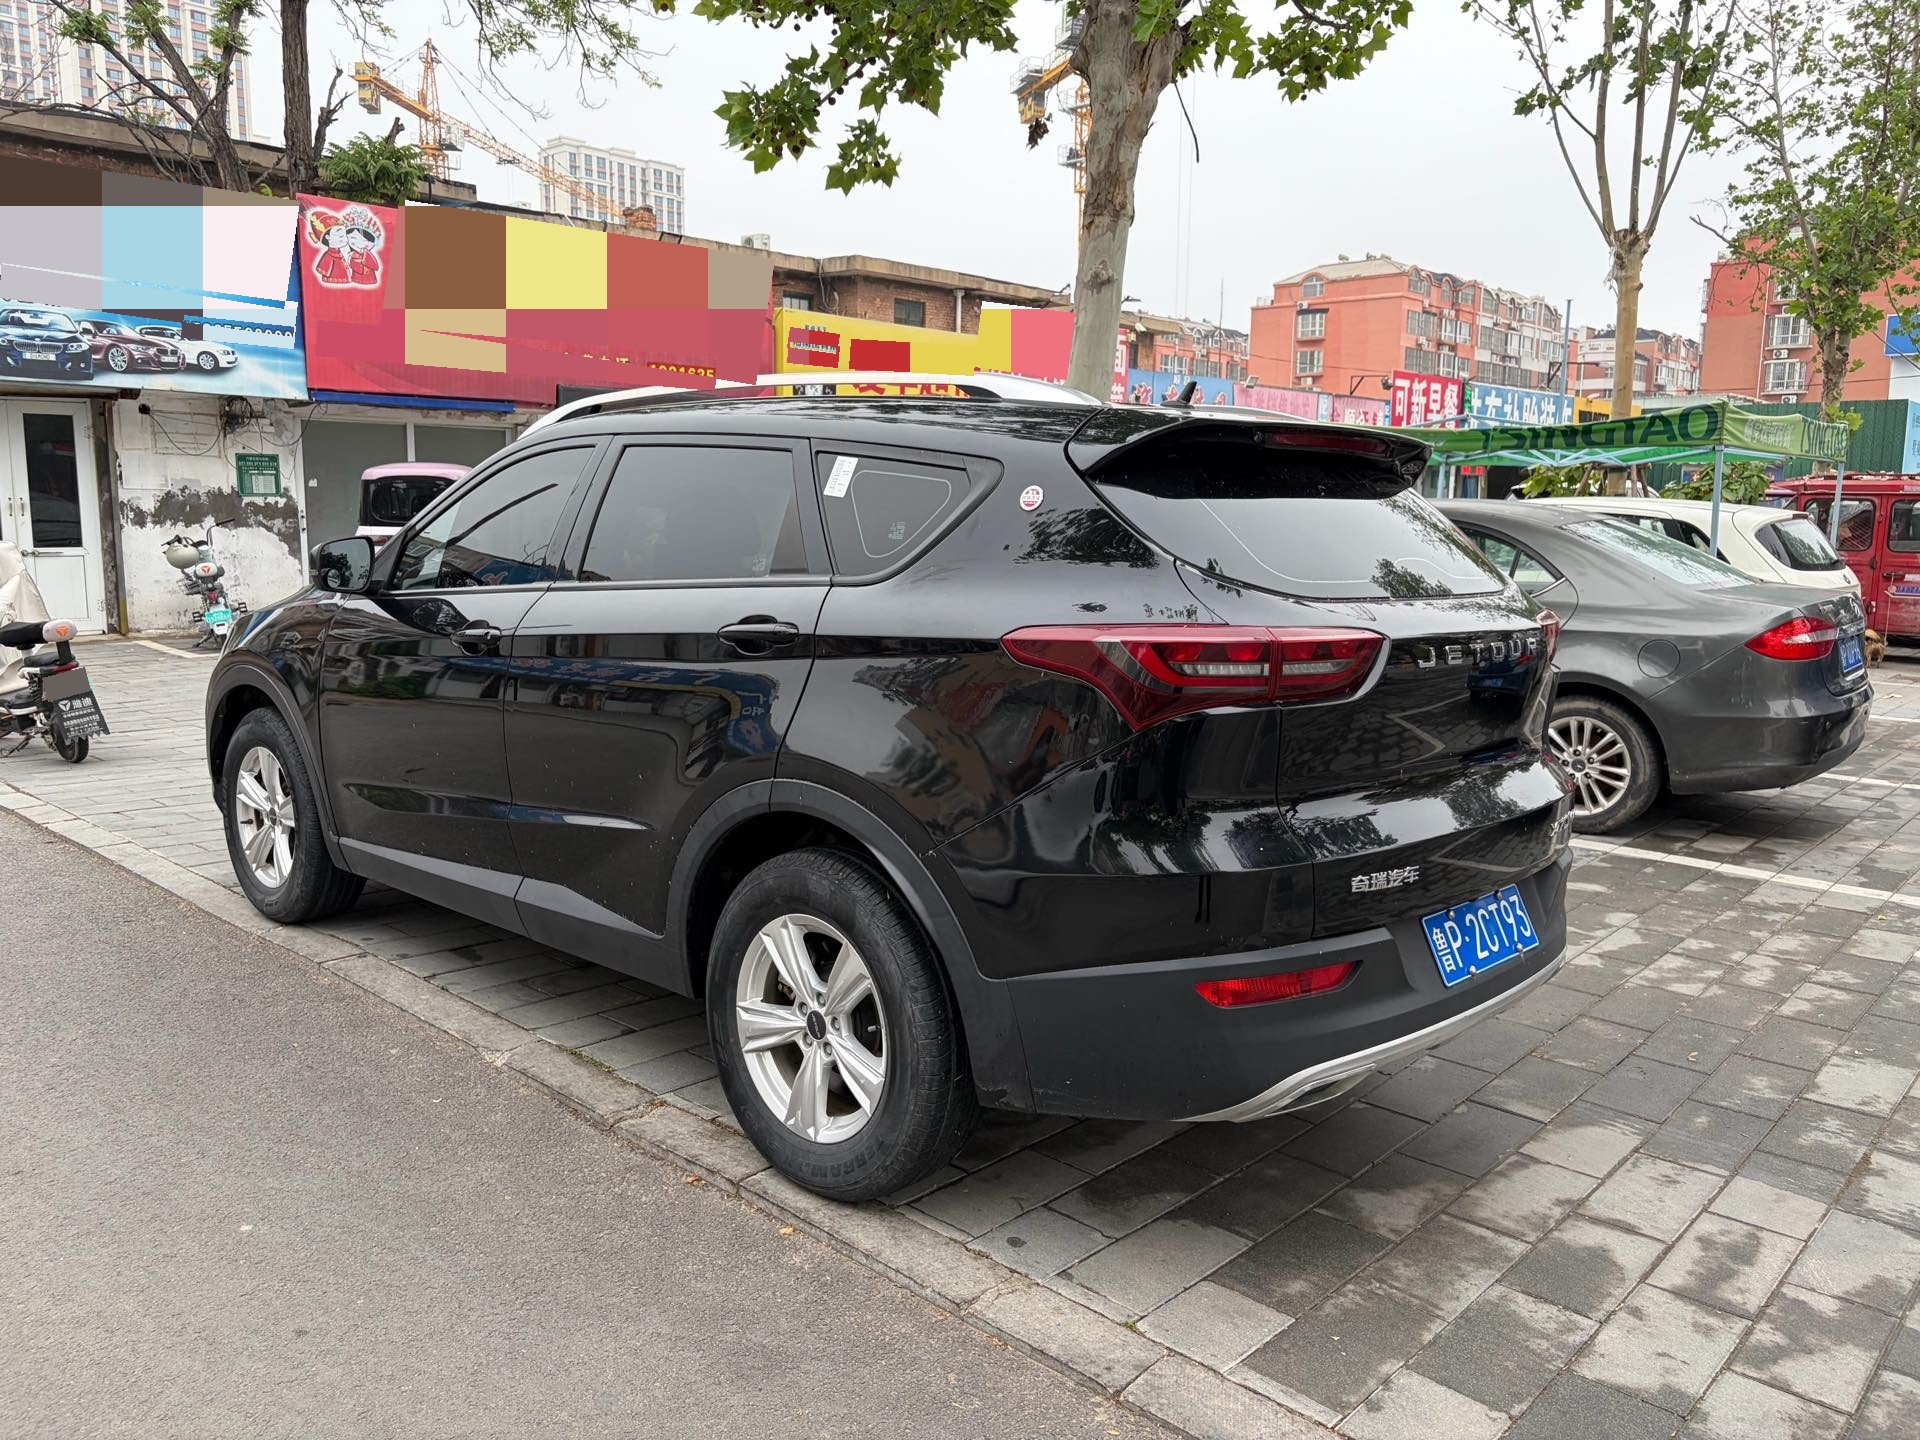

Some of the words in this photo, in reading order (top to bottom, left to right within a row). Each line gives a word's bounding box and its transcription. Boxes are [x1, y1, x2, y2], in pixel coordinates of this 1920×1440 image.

[1417, 638, 1538, 668] JETOUR
[1351, 865, 1420, 893] 奇瑞汽车
